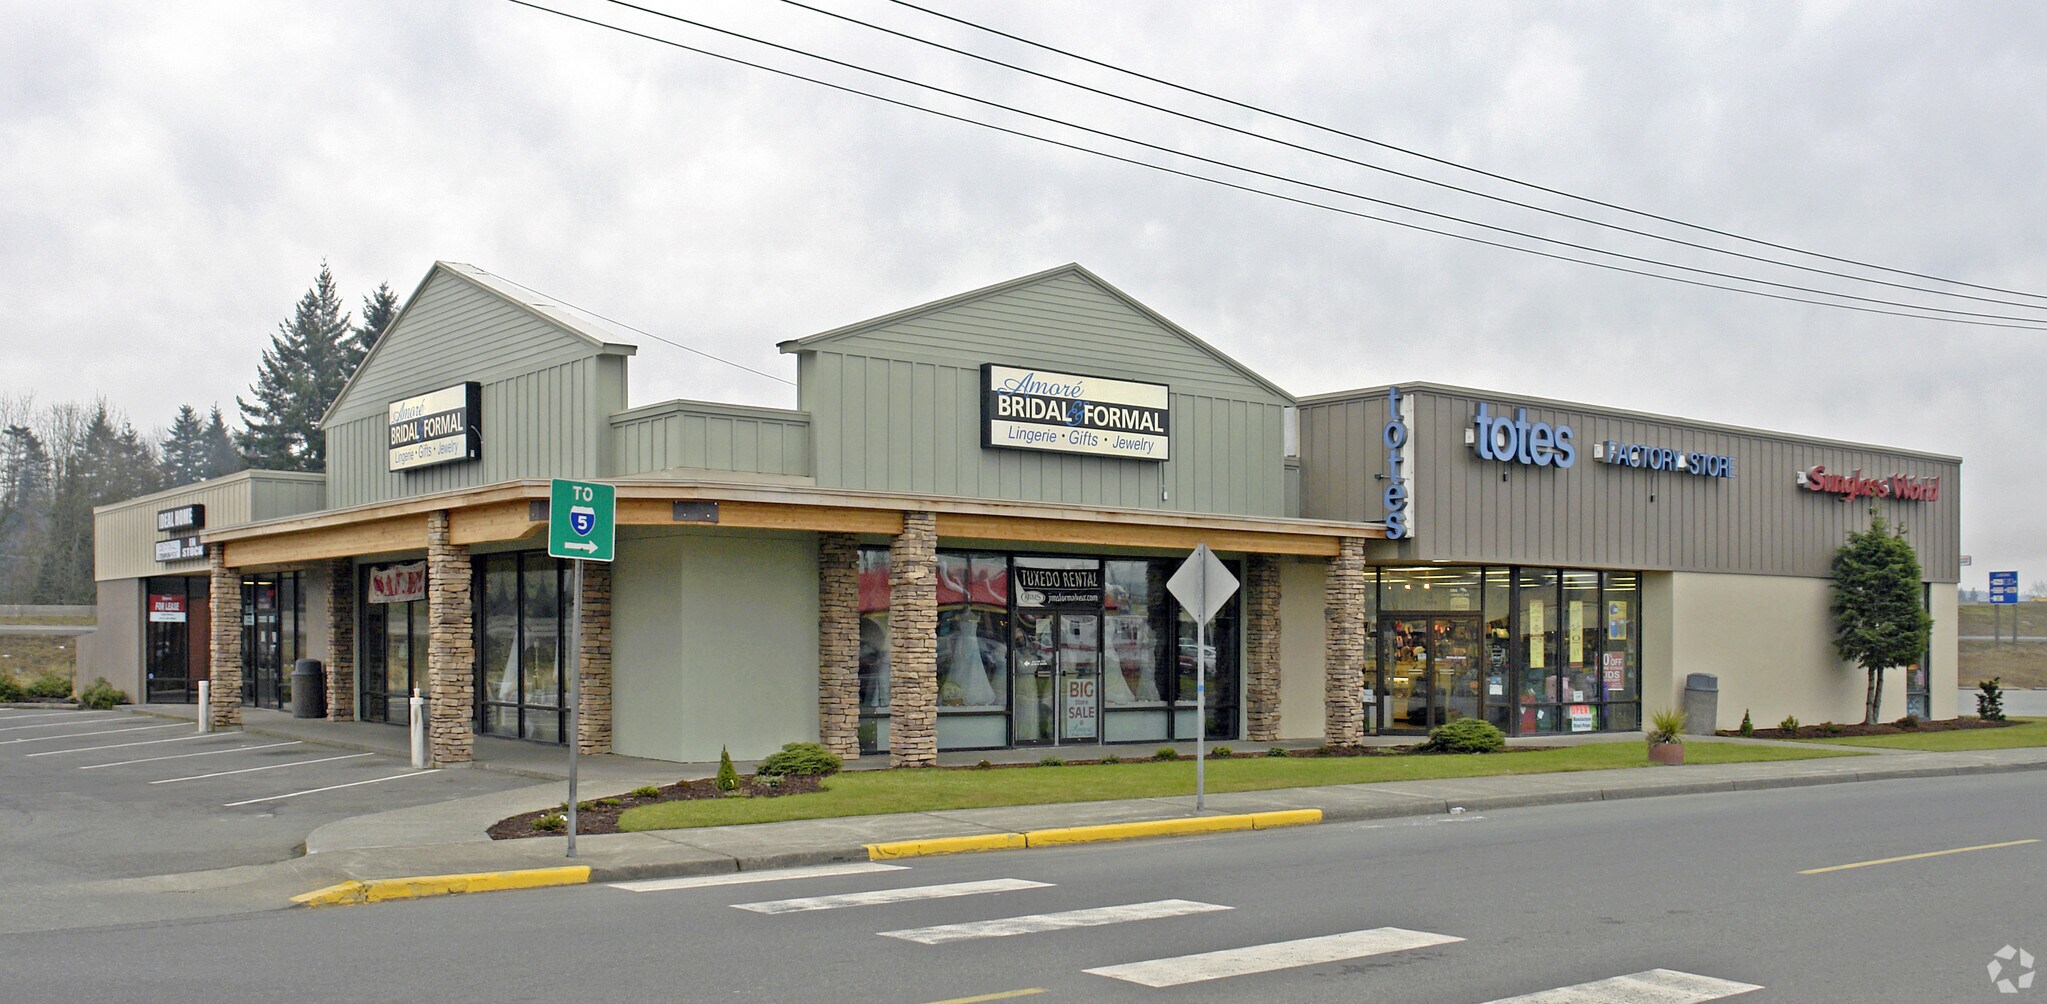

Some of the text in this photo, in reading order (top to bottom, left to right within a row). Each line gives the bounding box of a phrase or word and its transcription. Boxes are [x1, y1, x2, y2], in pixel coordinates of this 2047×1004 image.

[997, 372, 1084, 399] Amoré
[998, 395, 1073, 422] BRIDAL
[1084, 404, 1164, 433] FORMAL
[391, 421, 420, 445] BRIDAL
[423, 412, 464, 438] FORMAL
[1008, 425, 1155, 455] Lingerie Gifts Jewelry
[1473, 402, 1576, 469] totes
[394, 440, 459, 465] Lingerie Gifts Jewelry
[1383, 386, 1408, 540] totes
[1605, 440, 1737, 478] FACTORY STORE
[572, 485, 593, 502] TO
[1807, 465, 1940, 502] Sunglass World
[577, 515, 587, 530] 5
[182, 544, 204, 558] STOCK
[1021, 569, 1098, 587] TUXEDO RENTAL
[155, 601, 180, 611] FOR LEASE
[1069, 680, 1094, 698] BIG
[1068, 706, 1095, 719] SALE
